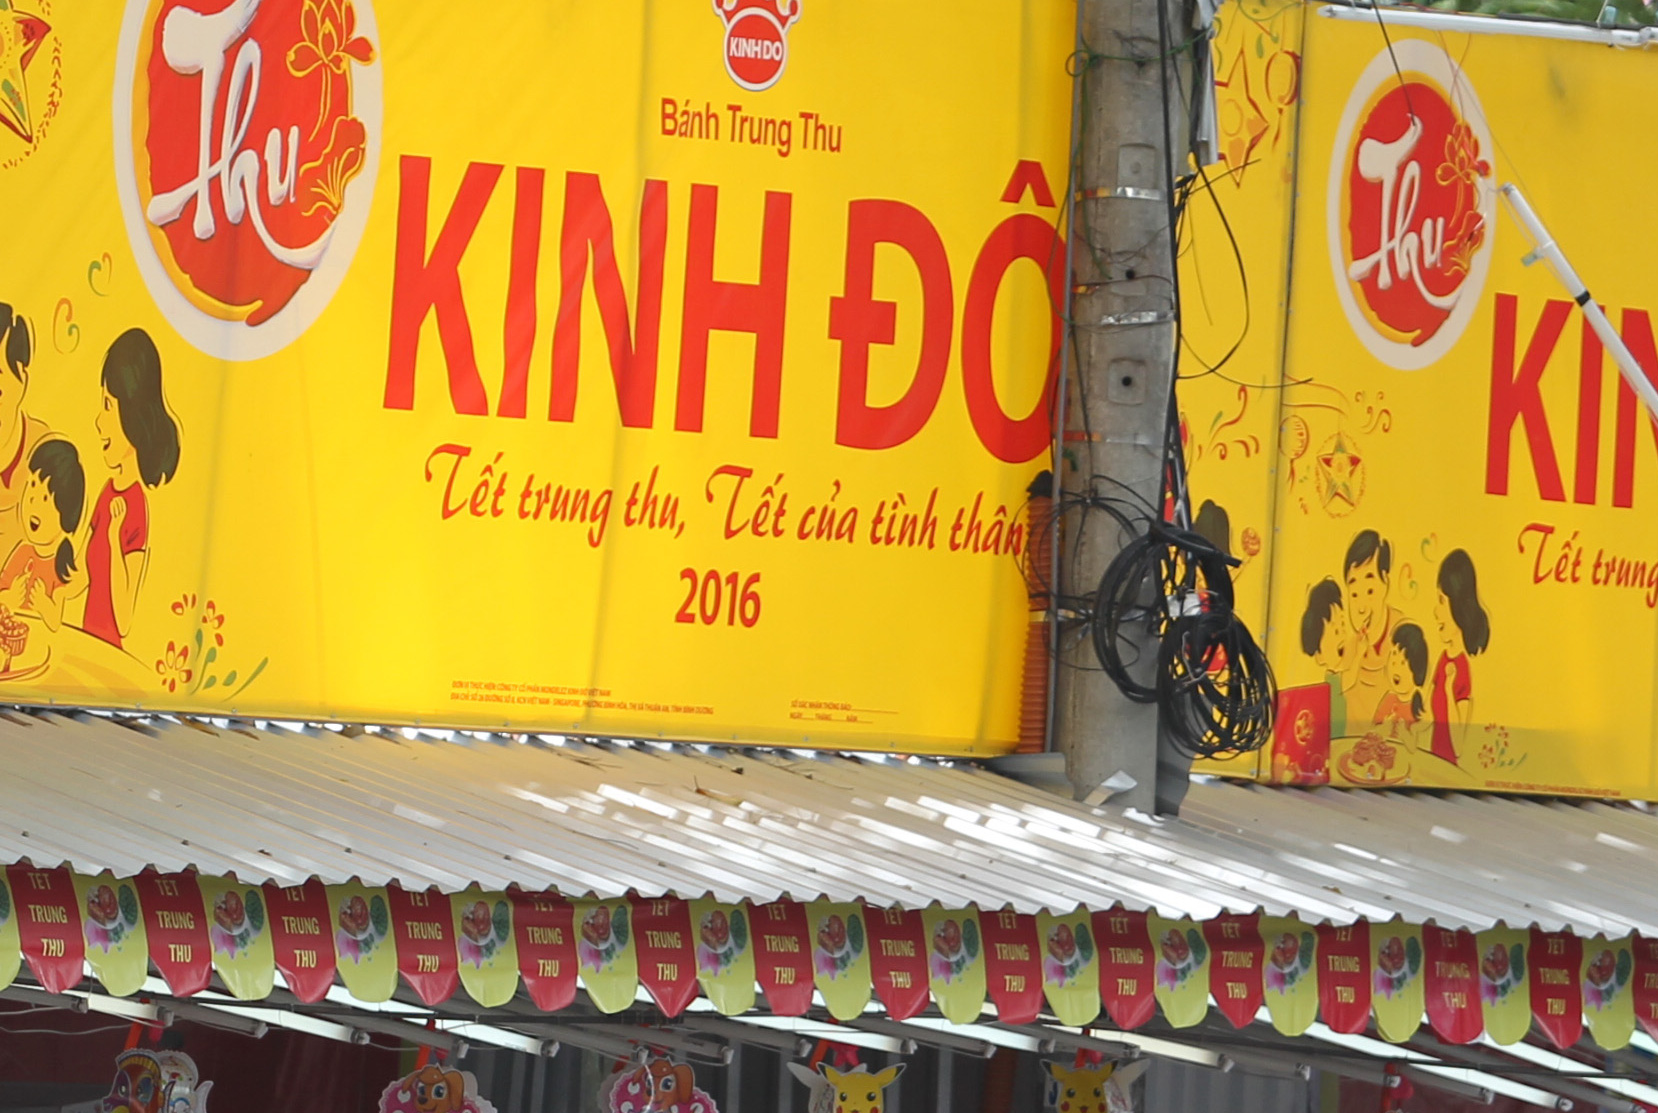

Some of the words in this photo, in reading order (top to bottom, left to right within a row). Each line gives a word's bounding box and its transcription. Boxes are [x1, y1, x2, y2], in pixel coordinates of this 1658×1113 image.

[147, 0, 337, 269] Thu
[661, 97, 720, 140] Bánh
[727, 104, 792, 158] Trung
[799, 112, 842, 153] Thu
[1349, 116, 1466, 309] Thu
[383, 155, 793, 439] KINH
[829, 160, 1068, 464] ĐÔ
[425, 443, 506, 521] Tết
[518, 474, 613, 548] trung
[623, 465, 687, 539] thu,
[705, 464, 788, 540] Tết
[797, 479, 856, 544] của
[870, 487, 939, 550] tình
[949, 487, 1024, 556] thân
[1517, 522, 1582, 585] Tết
[675, 568, 761, 628] 2016
[29, 905, 67, 923] TRUNG
[157, 912, 194, 929] TRUNG
[282, 917, 320, 934] TRUNG
[406, 922, 442, 939] TRUNG
[527, 927, 563, 944] TRUNG
[646, 931, 681, 948] TRUNG
[765, 936, 799, 952] TRUNG
[42, 939, 64, 957] THU
[169, 945, 191, 962] THU
[881, 940, 915, 956] TRUNG
[996, 944, 1029, 960] TRUNG
[1110, 948, 1143, 964] TRUNG
[294, 950, 316, 968] THU
[417, 955, 438, 972] THU
[1223, 951, 1253, 968] TRUNG
[1328, 956, 1359, 972] TRUNG
[539, 960, 558, 977] THU
[658, 964, 677, 980] THU
[775, 968, 794, 984] THU
[1436, 962, 1470, 979] TRUNG
[1540, 968, 1569, 984] TRUNG
[890, 972, 910, 988] THU
[1005, 976, 1024, 992] THU
[1118, 979, 1136, 995] THU
[1227, 983, 1246, 998] THU
[1336, 987, 1354, 1003] THU
[1444, 993, 1466, 1008] THU
[1548, 999, 1564, 1014] THU
